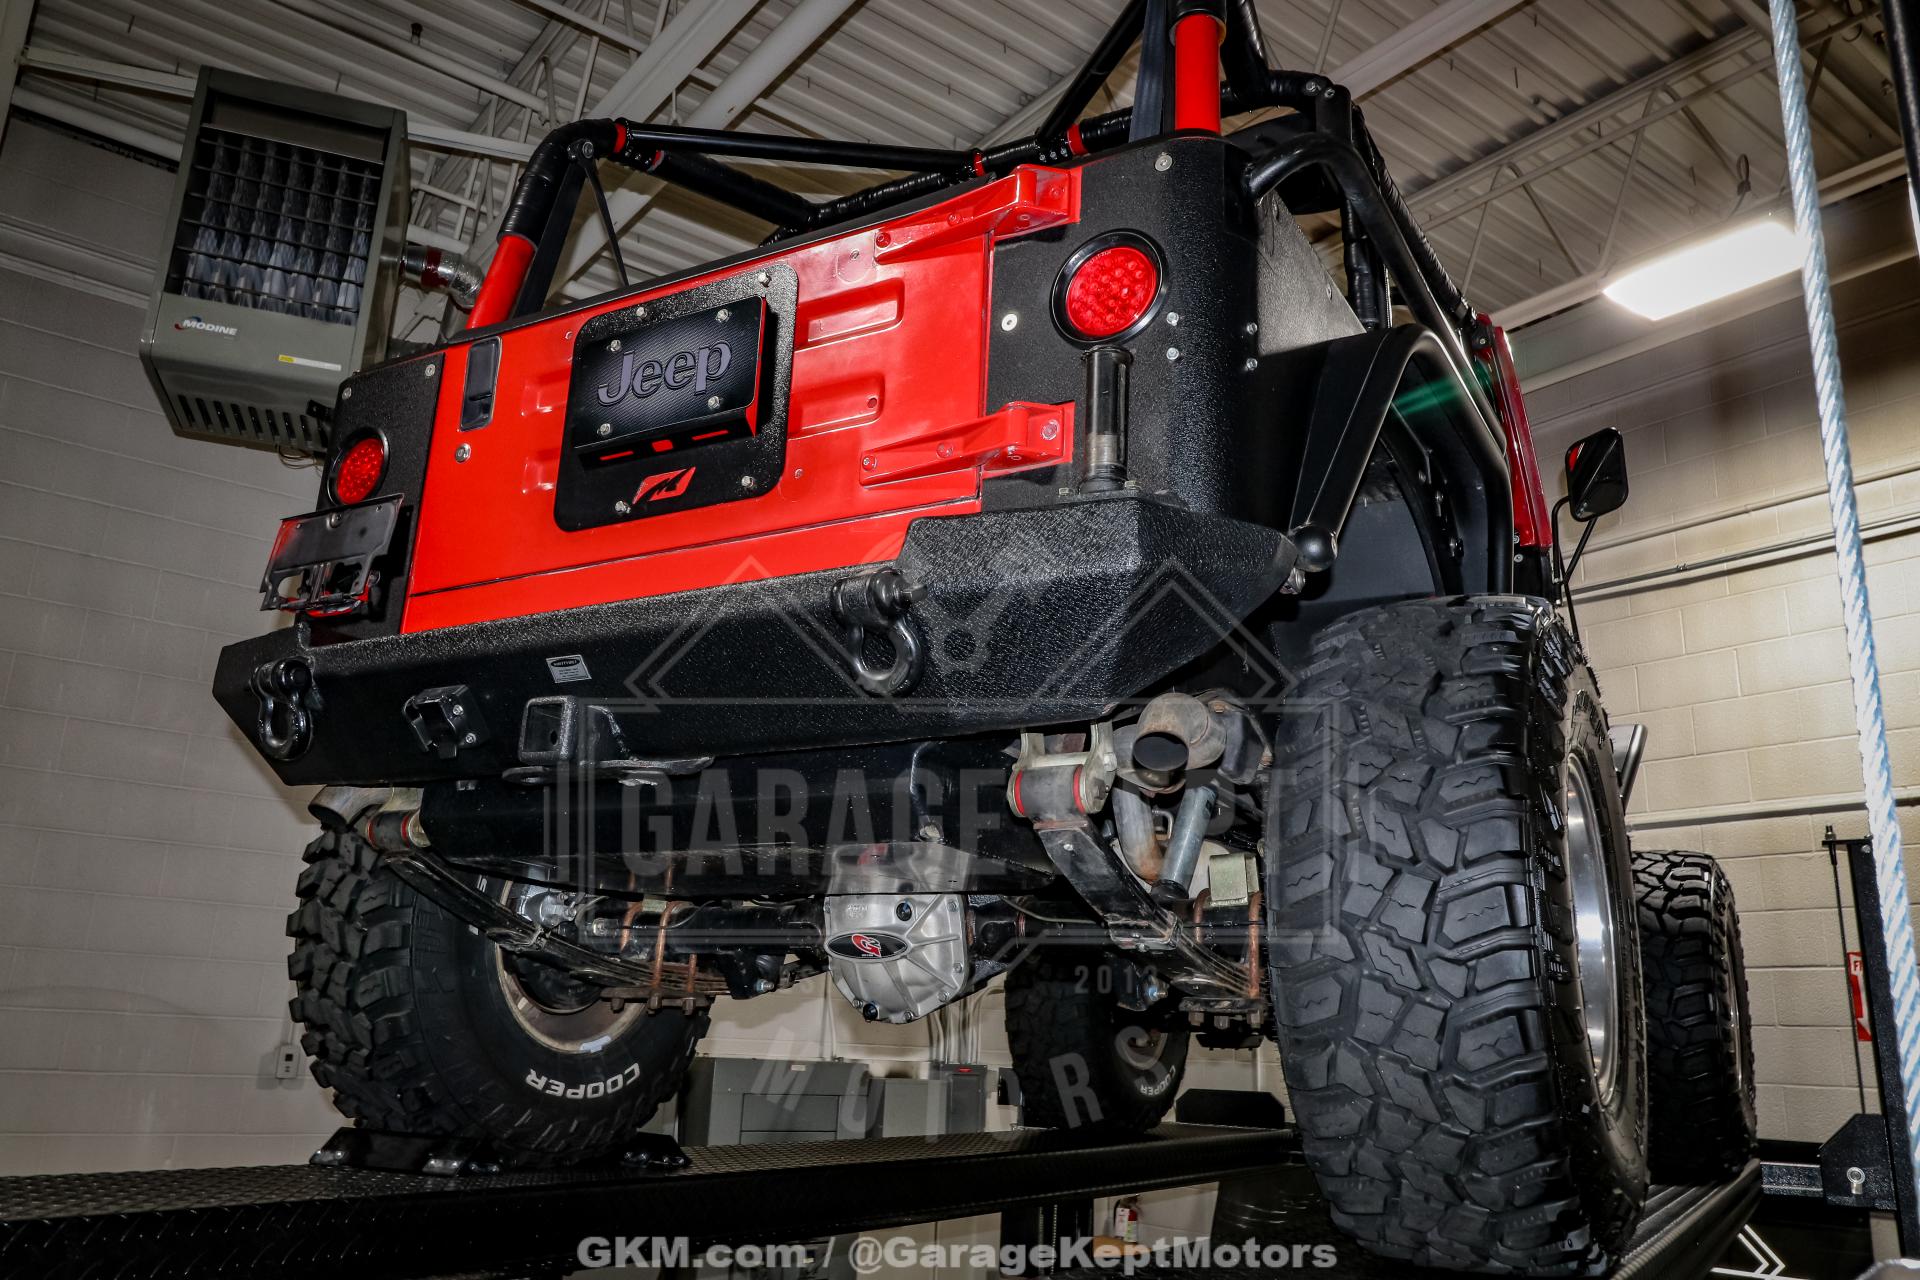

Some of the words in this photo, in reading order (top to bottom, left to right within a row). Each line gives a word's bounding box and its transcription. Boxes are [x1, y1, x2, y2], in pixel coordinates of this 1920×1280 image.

[181, 317, 238, 336] MODINE
[597, 339, 733, 406] Jeep
[525, 1062, 641, 1099] COOPER
